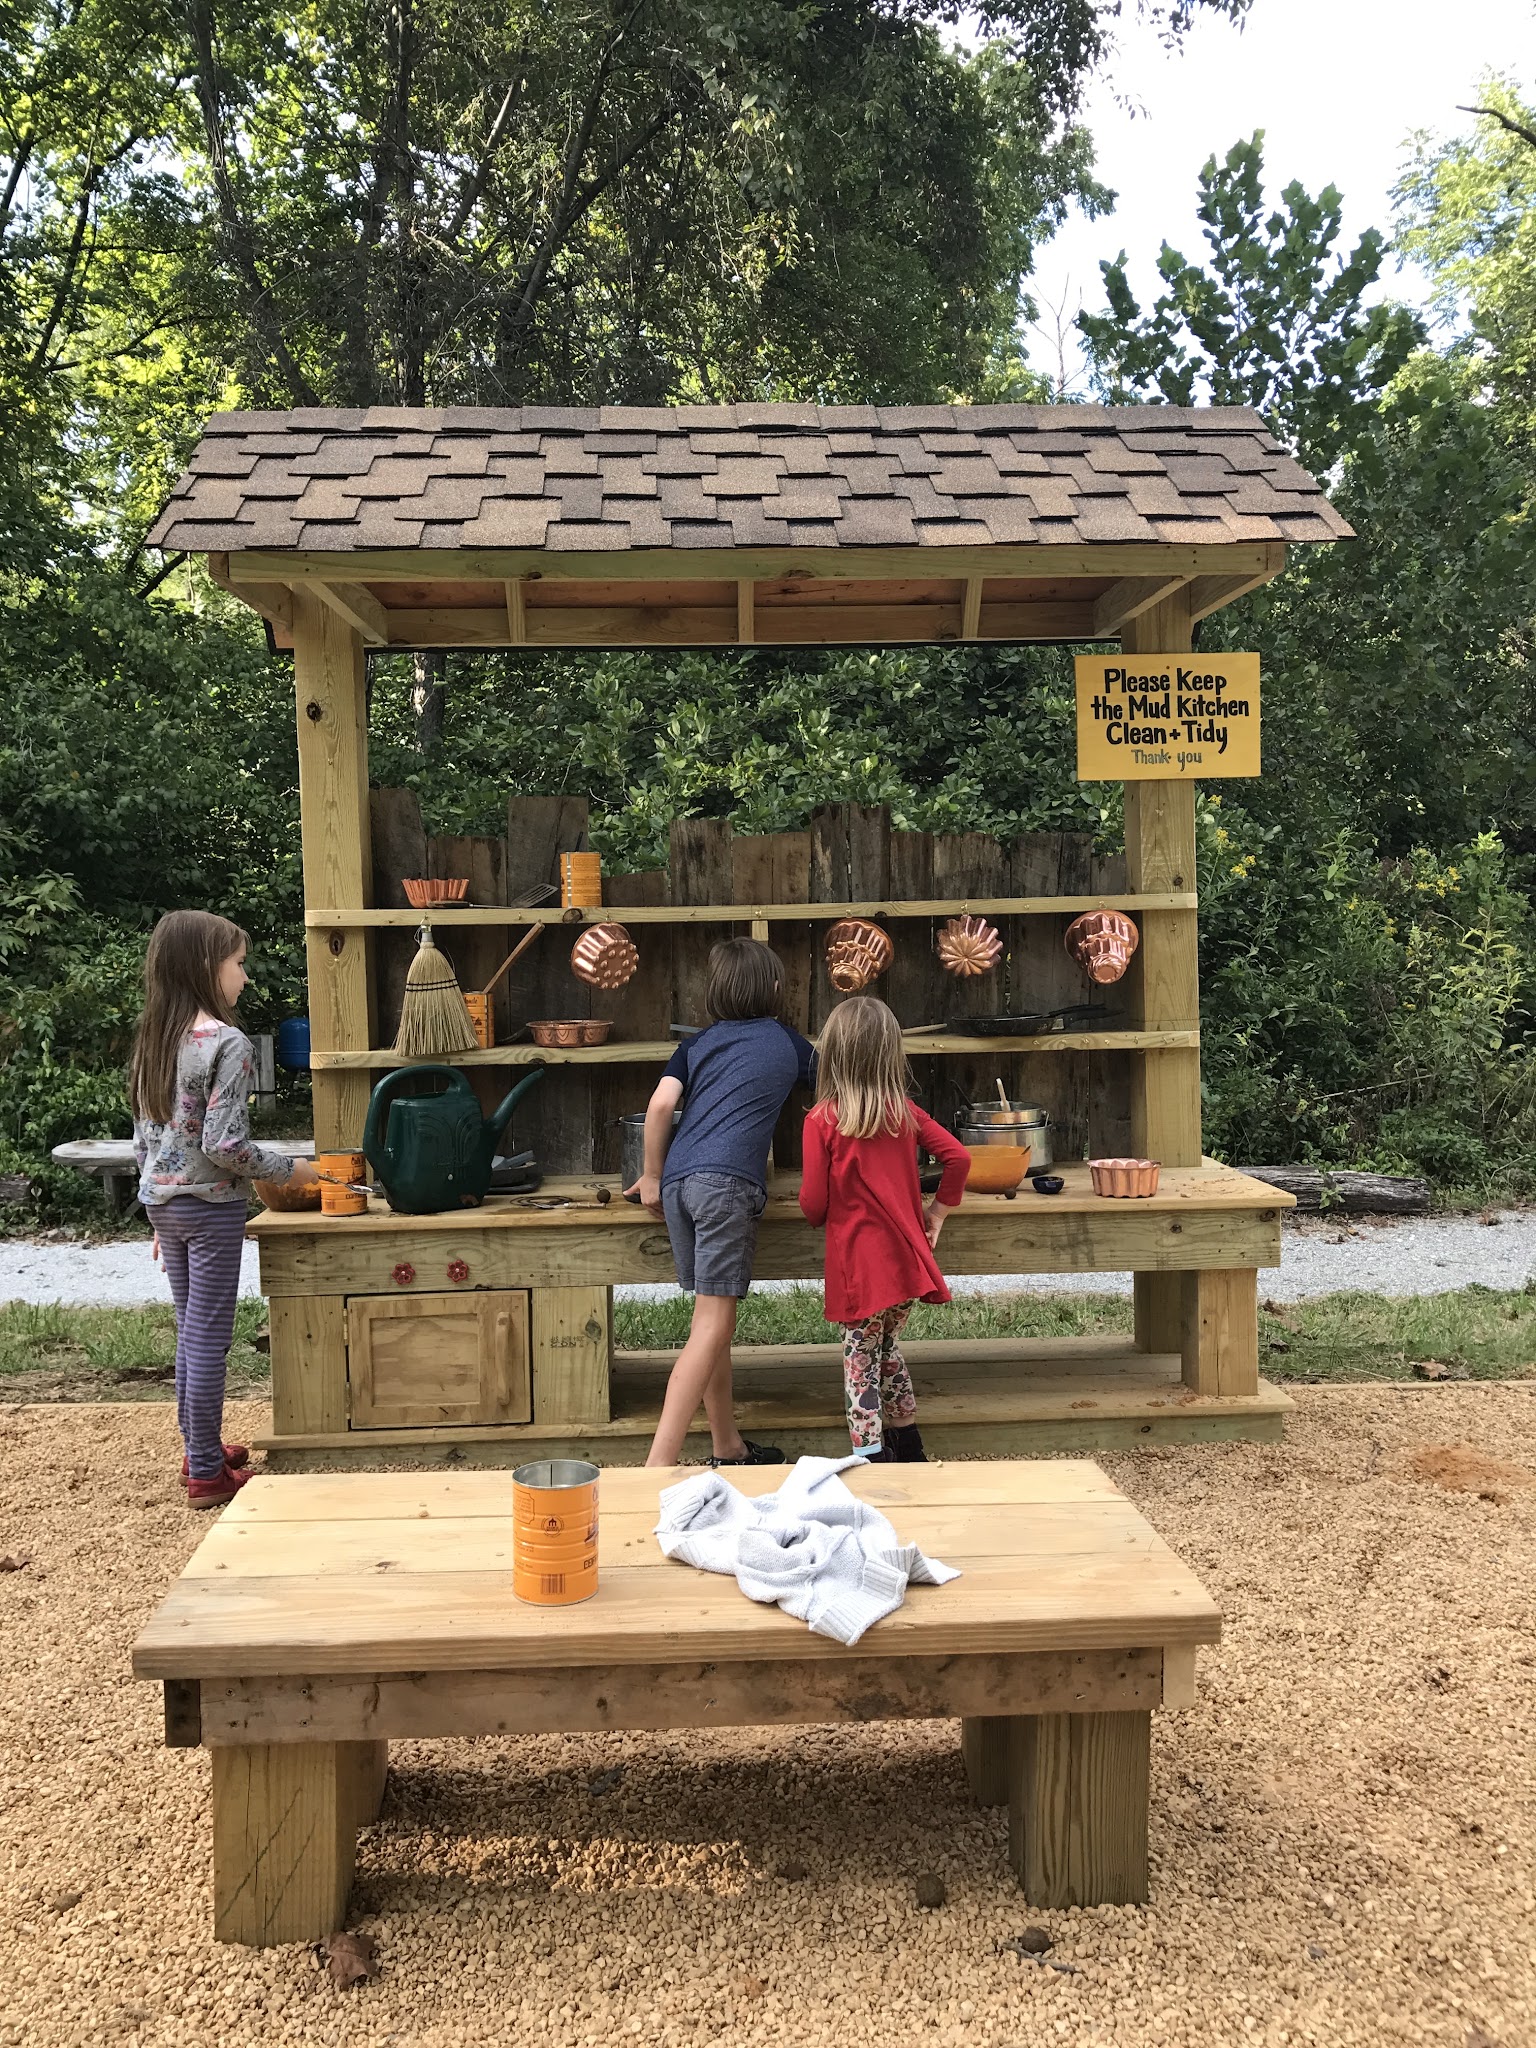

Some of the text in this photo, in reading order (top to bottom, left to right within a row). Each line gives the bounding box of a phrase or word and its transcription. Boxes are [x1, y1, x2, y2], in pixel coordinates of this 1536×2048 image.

[1104, 668, 1227, 695] Please Keep
[1091, 693, 1249, 720] the Mud Kitchen
[1106, 722, 1167, 744] Clean
[1181, 719, 1227, 754] Tidy
[1131, 749, 1202, 771] Thank you
